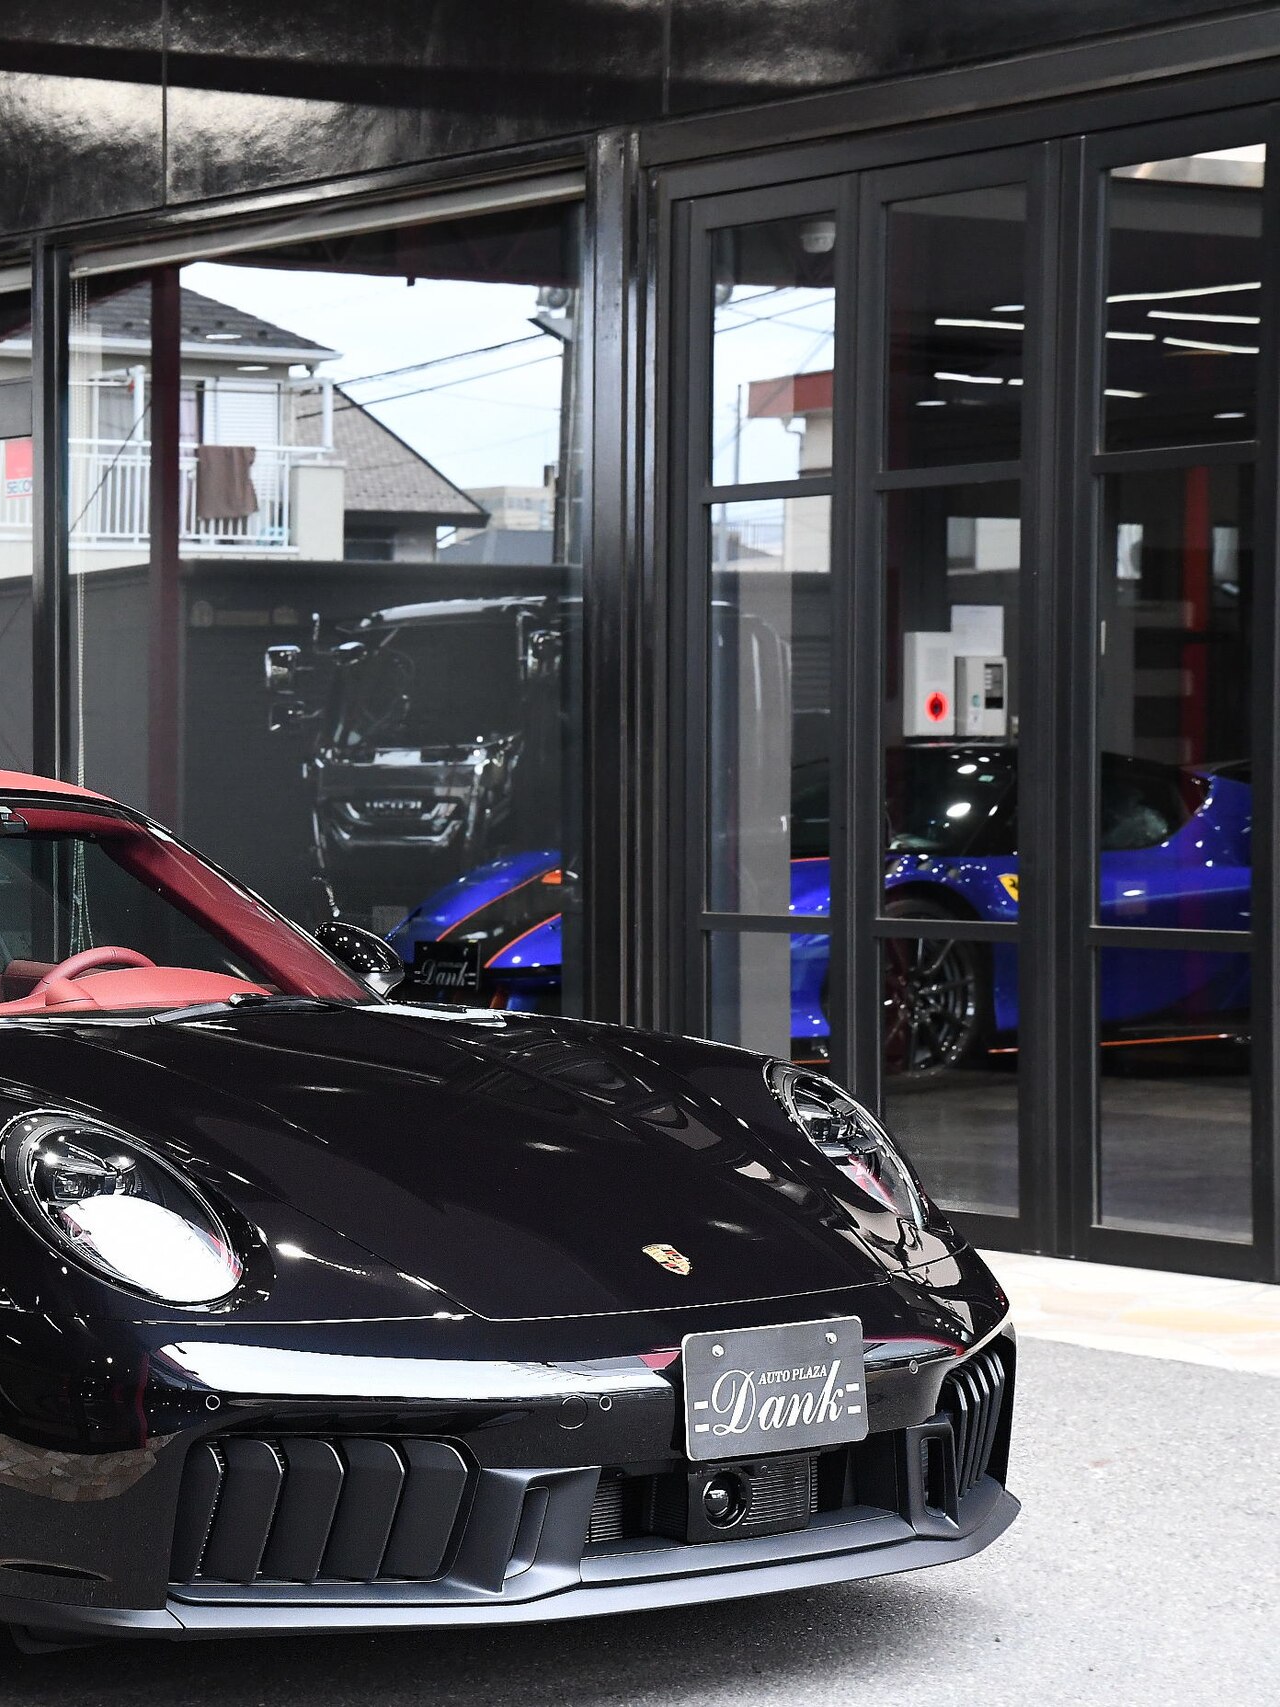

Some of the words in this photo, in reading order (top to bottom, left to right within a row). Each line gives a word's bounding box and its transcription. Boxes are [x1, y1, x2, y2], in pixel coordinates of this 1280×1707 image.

[6, 479, 33, 494] SECO
[420, 958, 469, 987] Dank
[758, 1369, 790, 1385] AUTO
[792, 1364, 827, 1381] PLAZA
[711, 1359, 844, 1436] Dank
